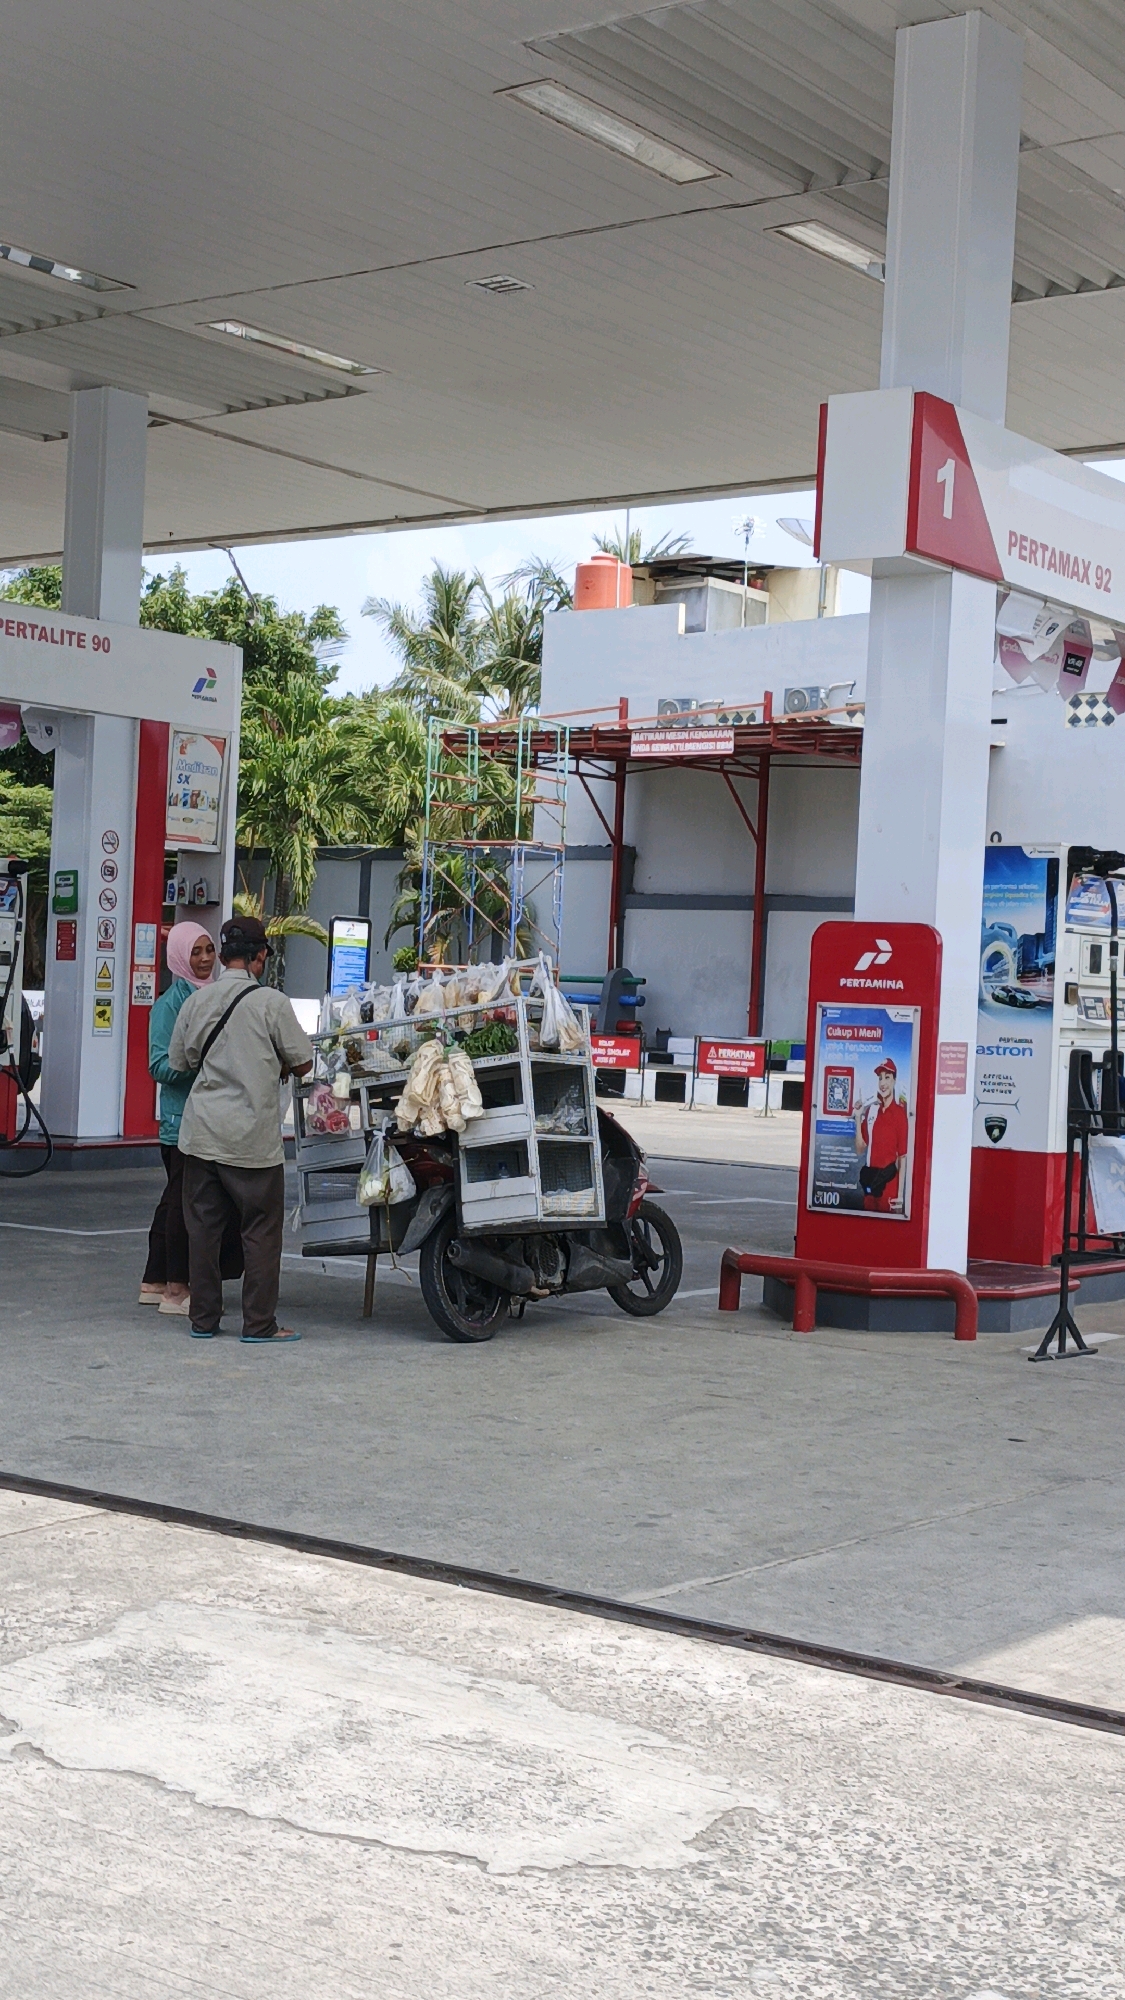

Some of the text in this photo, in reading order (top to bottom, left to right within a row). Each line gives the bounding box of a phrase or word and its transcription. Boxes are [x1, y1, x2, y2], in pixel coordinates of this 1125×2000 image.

[936, 458, 956, 520] 1
[1008, 529, 1112, 593] PERTAMAX 92
[91, 634, 111, 653] 90
[666, 731, 689, 740] MESIN
[176, 759, 218, 776] Meditran
[177, 773, 191, 785] SX
[840, 978, 904, 990] PERTAMINA
[827, 1026, 882, 1039] Cukup 1 Menit
[718, 1048, 755, 1060] PERHATIAN
[976, 1044, 1033, 1057] astron
